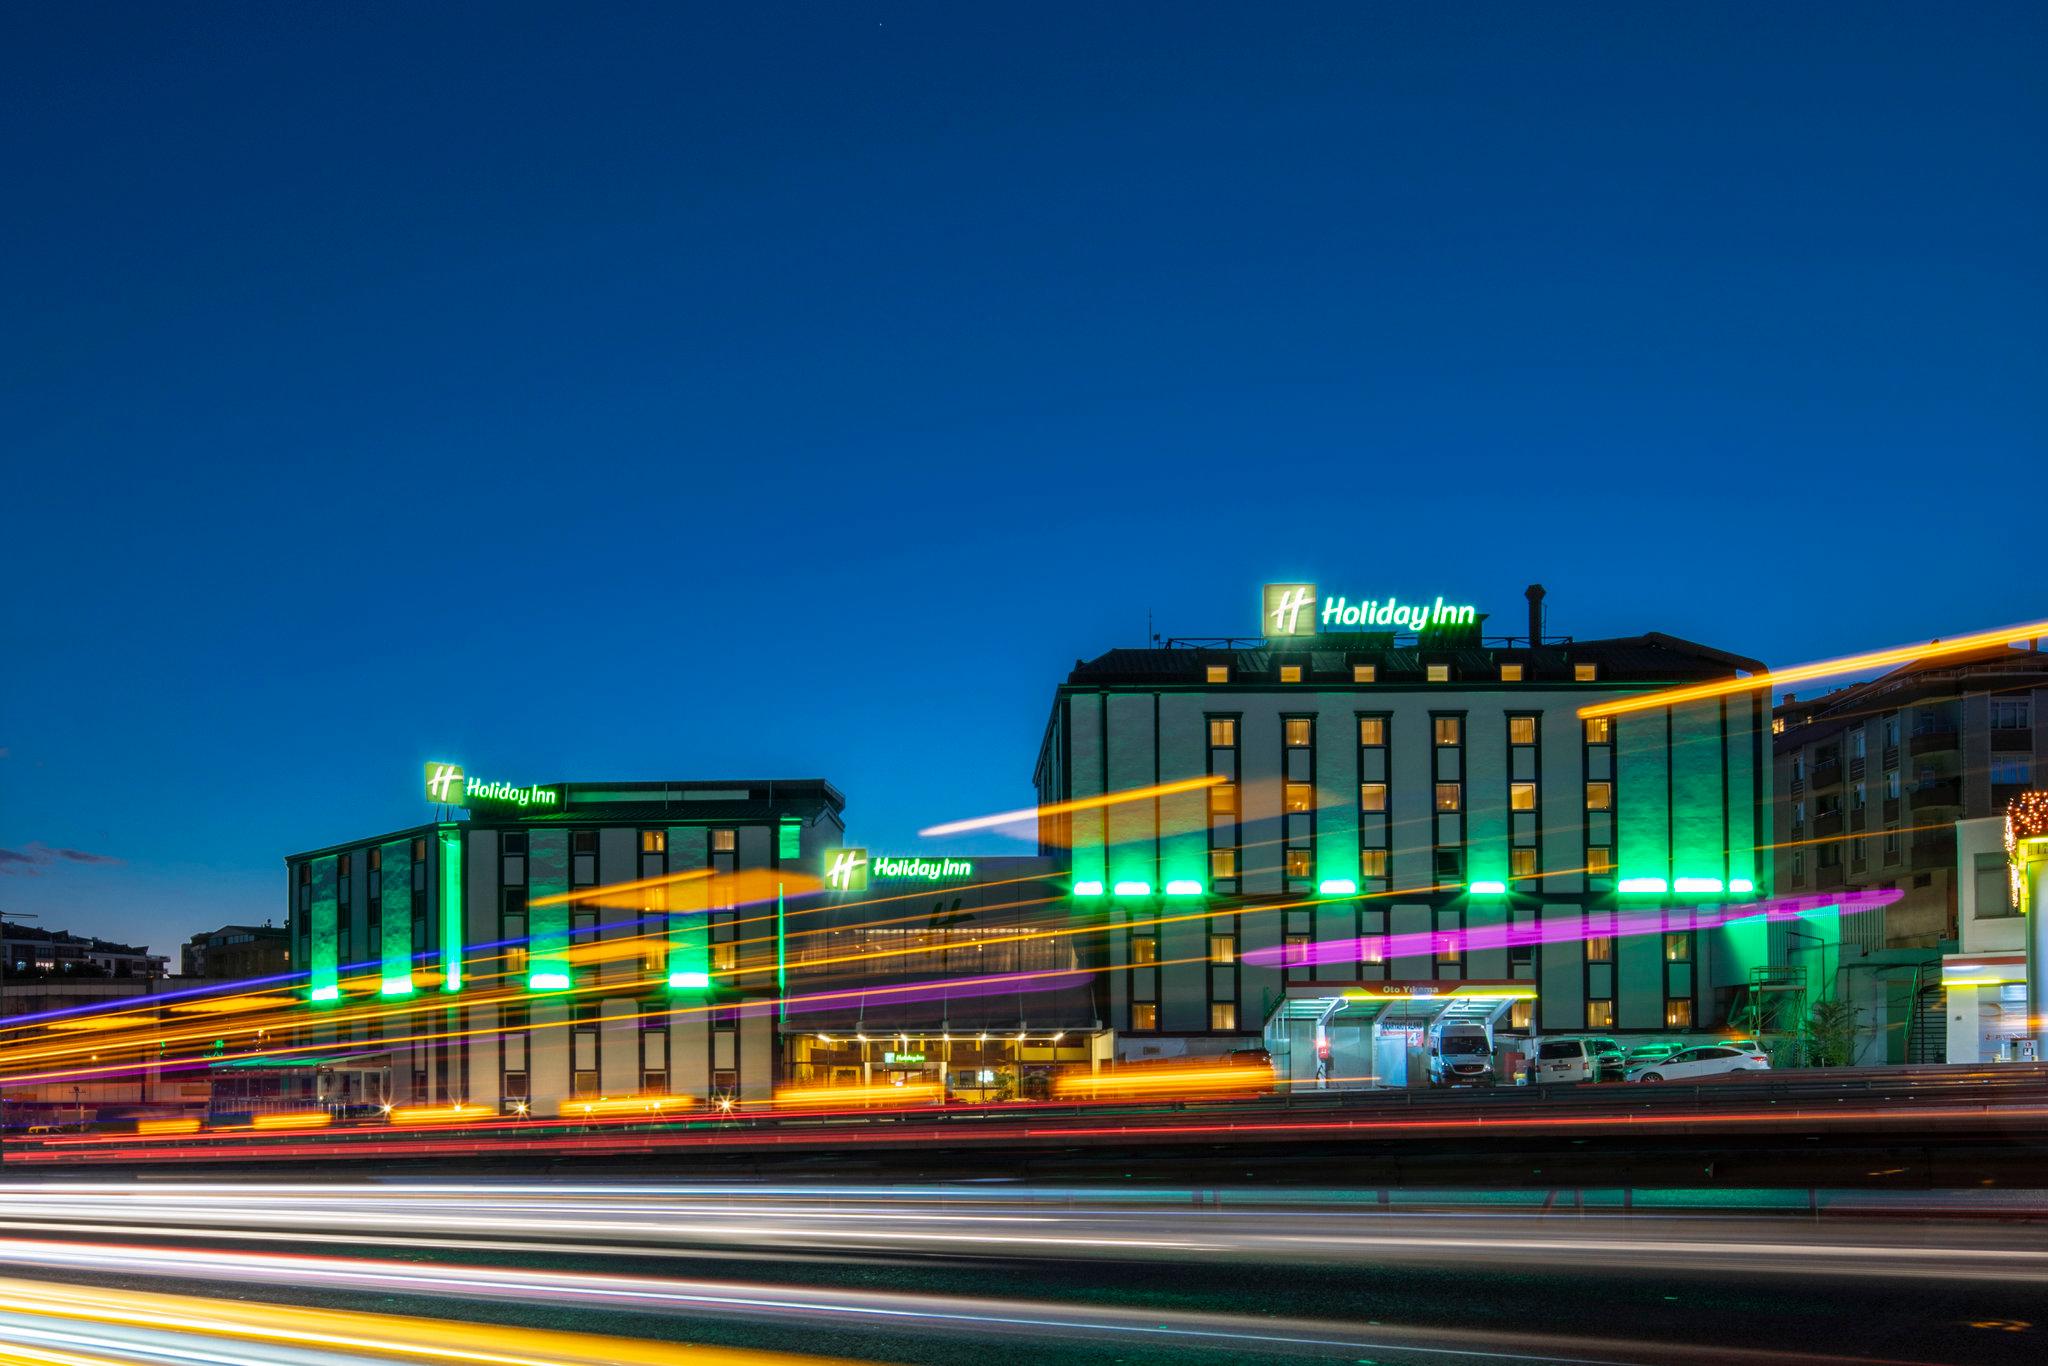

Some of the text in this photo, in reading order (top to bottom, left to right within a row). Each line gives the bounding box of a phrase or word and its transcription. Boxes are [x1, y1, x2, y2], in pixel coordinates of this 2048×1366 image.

[1321, 596, 1476, 631] Holiday Inn
[466, 776, 556, 806] Holiday Inn
[873, 857, 972, 880] Holiday Inn
[1382, 985, 1400, 994] Oto
